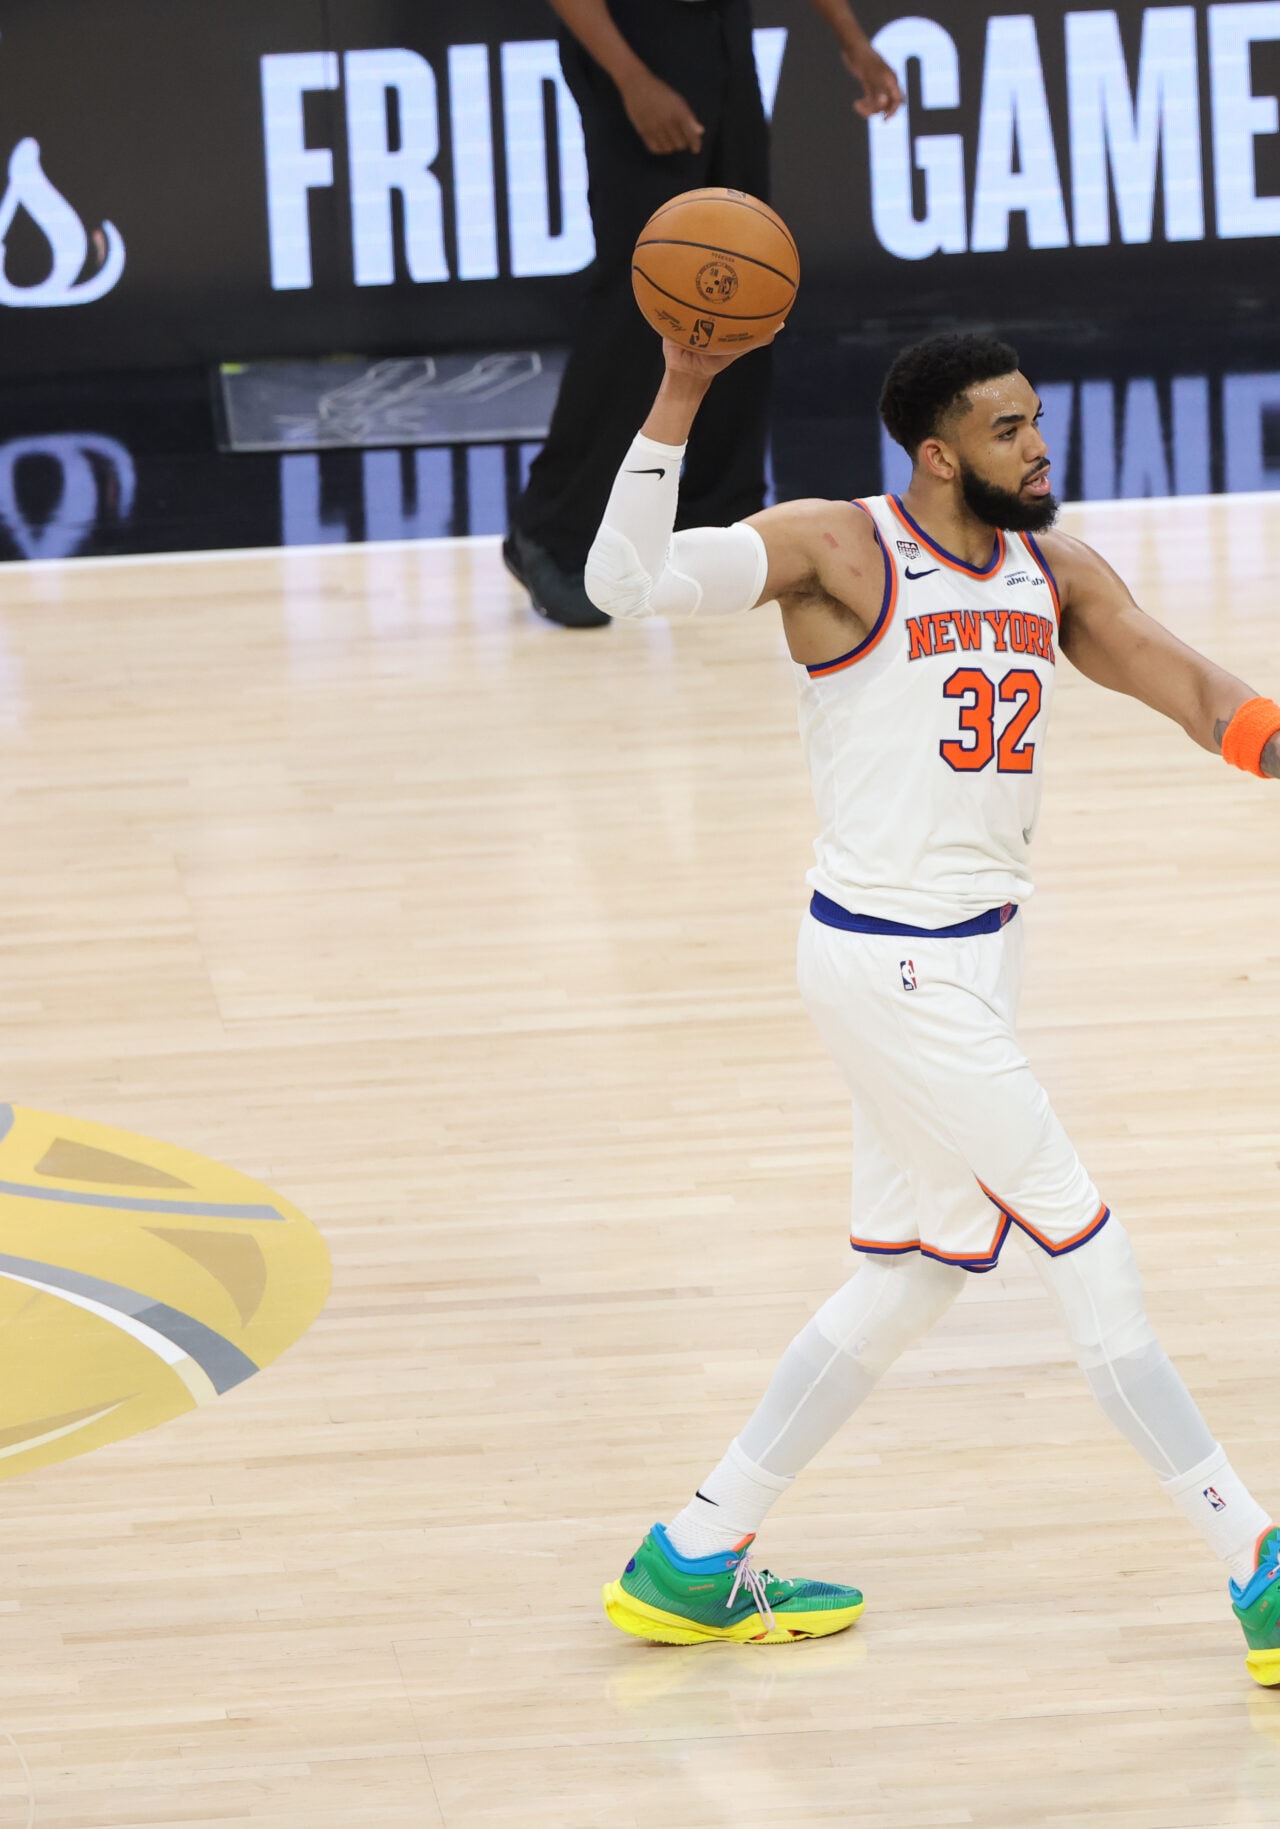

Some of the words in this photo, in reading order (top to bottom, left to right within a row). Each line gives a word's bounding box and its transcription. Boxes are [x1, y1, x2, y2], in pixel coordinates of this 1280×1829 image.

[261, 27, 788, 291] FRID
[906, 609, 982, 661] NEW
[983, 609, 1056, 666] YORK
[940, 667, 1042, 773] 32
